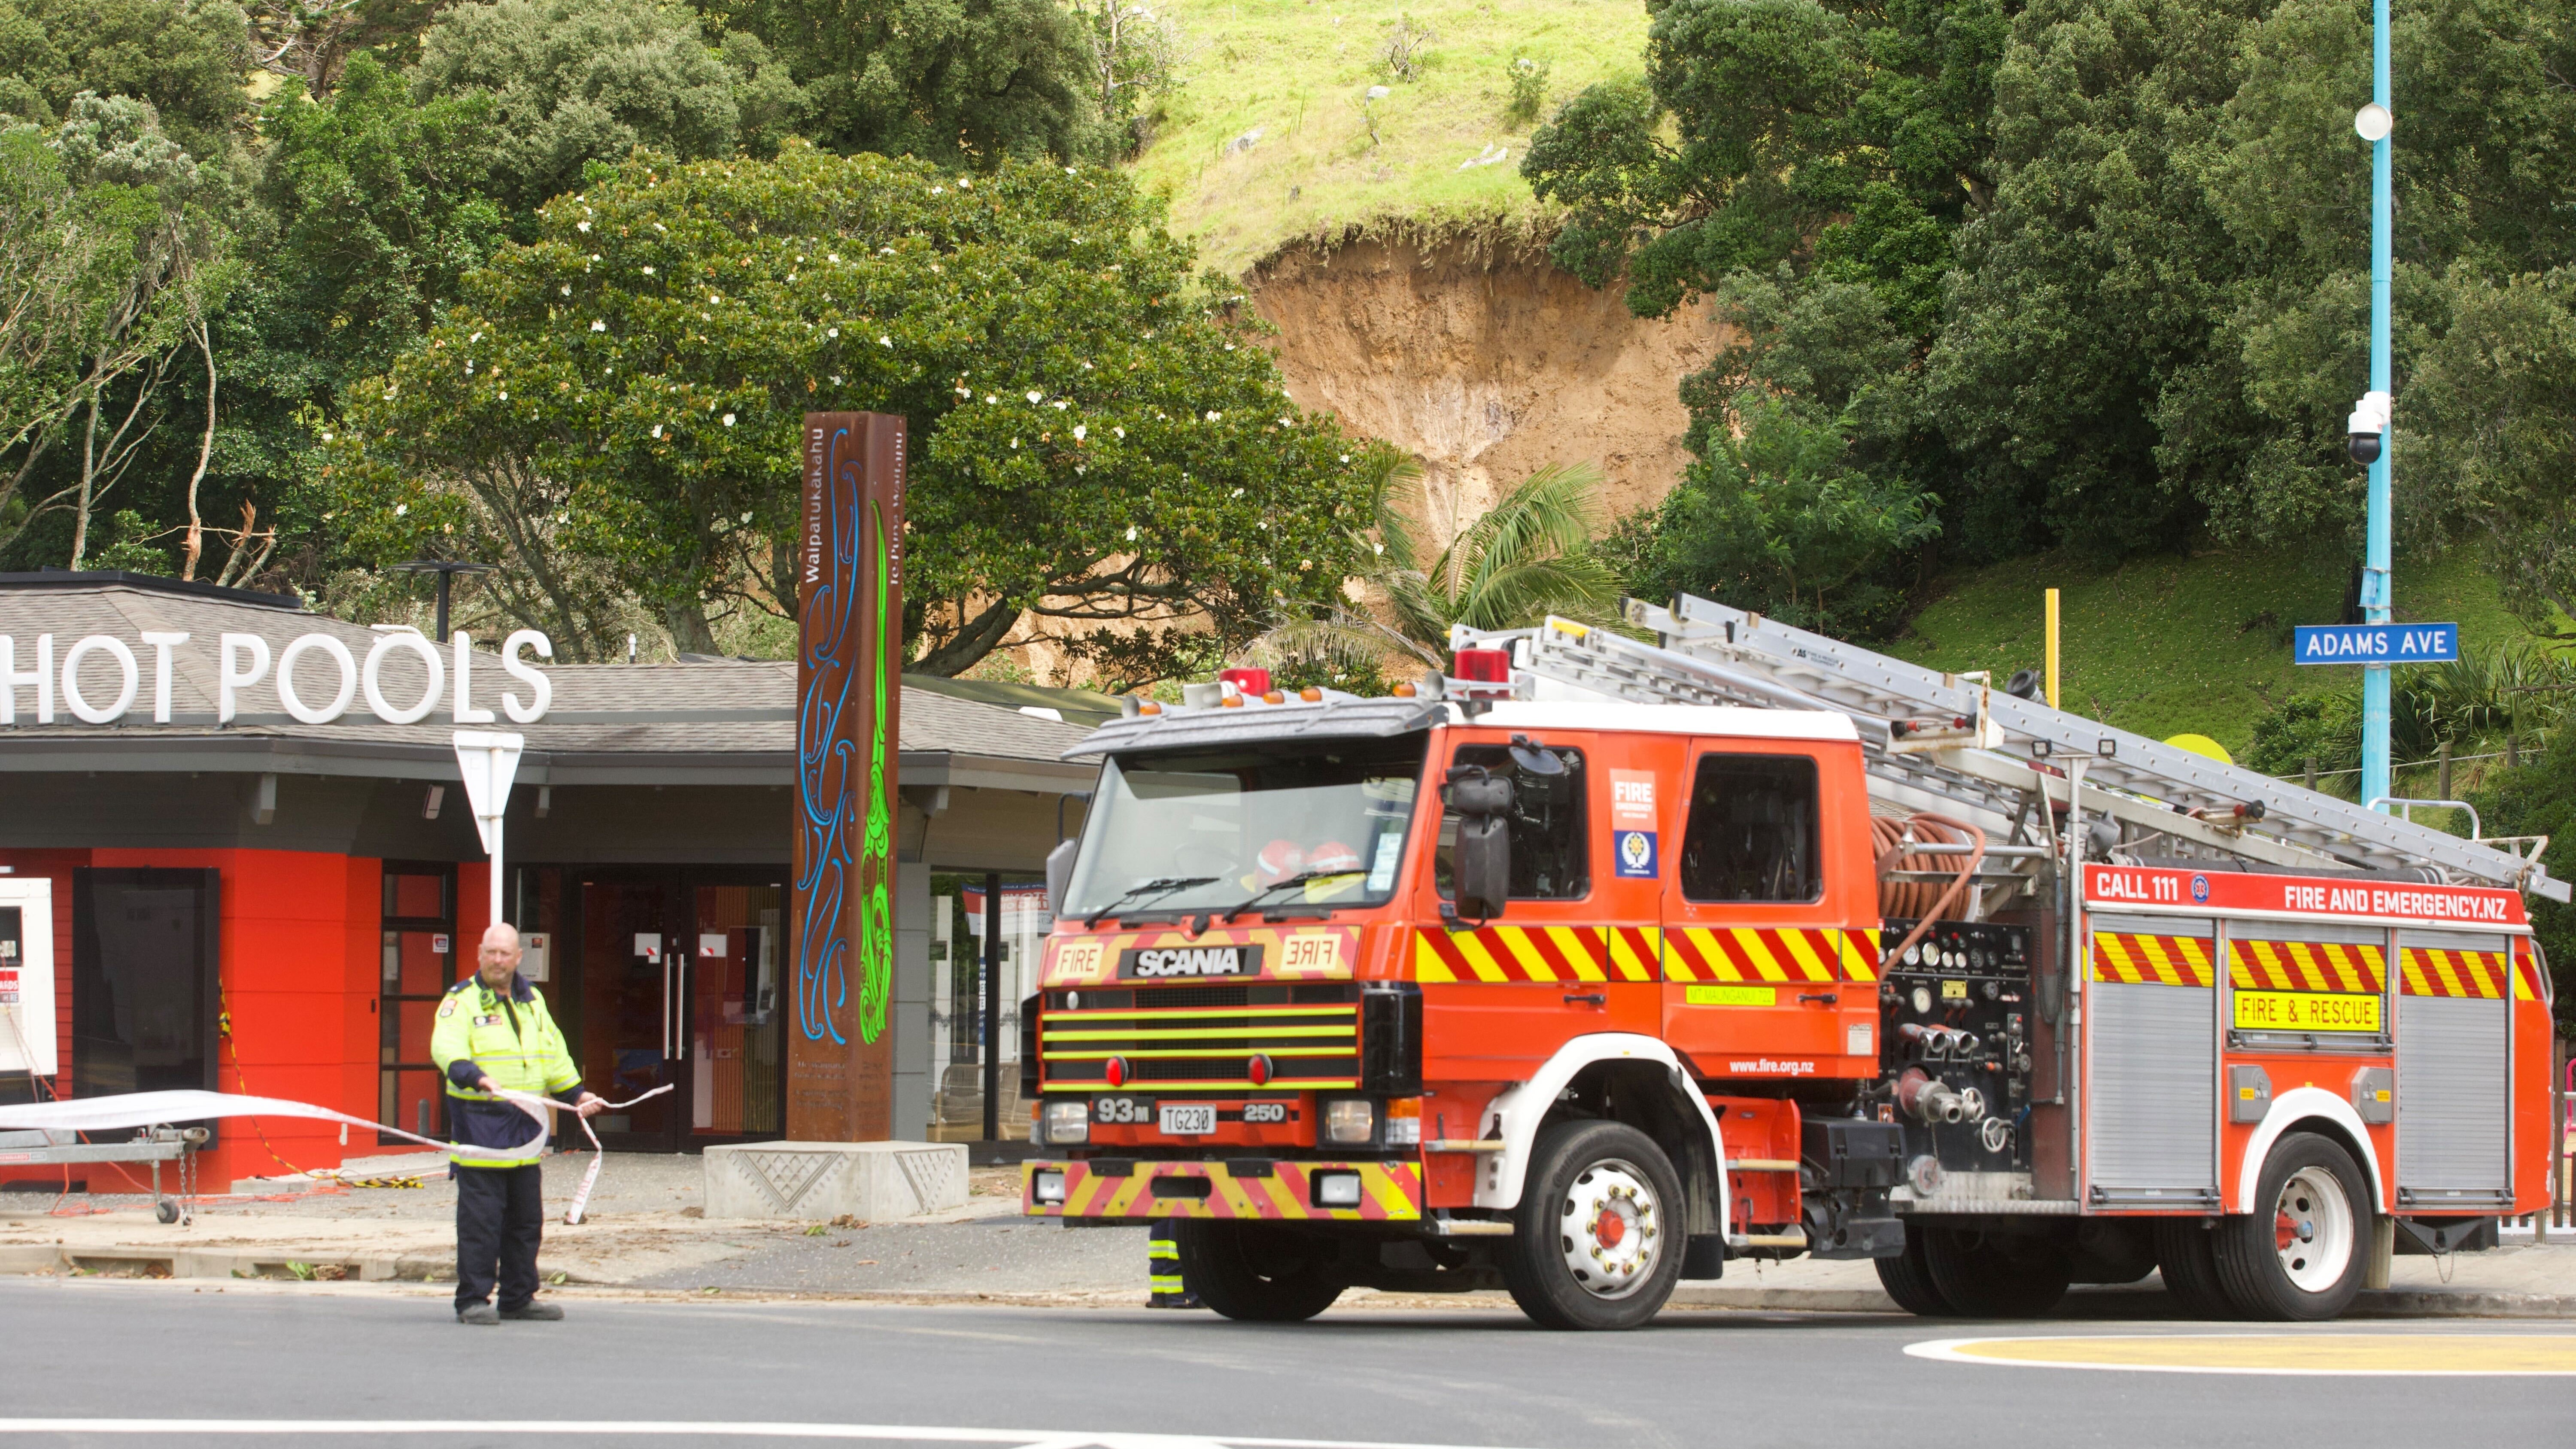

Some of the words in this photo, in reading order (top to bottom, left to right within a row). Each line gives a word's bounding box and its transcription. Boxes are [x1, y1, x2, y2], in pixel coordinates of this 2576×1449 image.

[805, 428, 823, 583] Waipatukakahu
[2306, 632, 2388, 656] ADAMS
[2400, 631, 2447, 654] AVE
[0, 632, 190, 724] HOT
[220, 629, 553, 724] POOLS
[1614, 781, 1653, 802] FIRE
[2097, 872, 2148, 899] CALL
[2152, 876, 2178, 901] 111
[2284, 885, 2326, 910] FIRE
[2330, 887, 2369, 912] AND
[2372, 890, 2507, 920] EMERGENCY.NZ
[1060, 948, 1097, 973] FIRE
[1136, 948, 1240, 976] SCANIA
[2242, 998, 2276, 1022] FIRE
[2288, 999, 2299, 1023] &
[2311, 1000, 2372, 1024] RESCUE
[1729, 1058, 1815, 1076] www.fire.org.nz
[1166, 1109, 1209, 1130] TG230
[1245, 1104, 1284, 1122] 250
